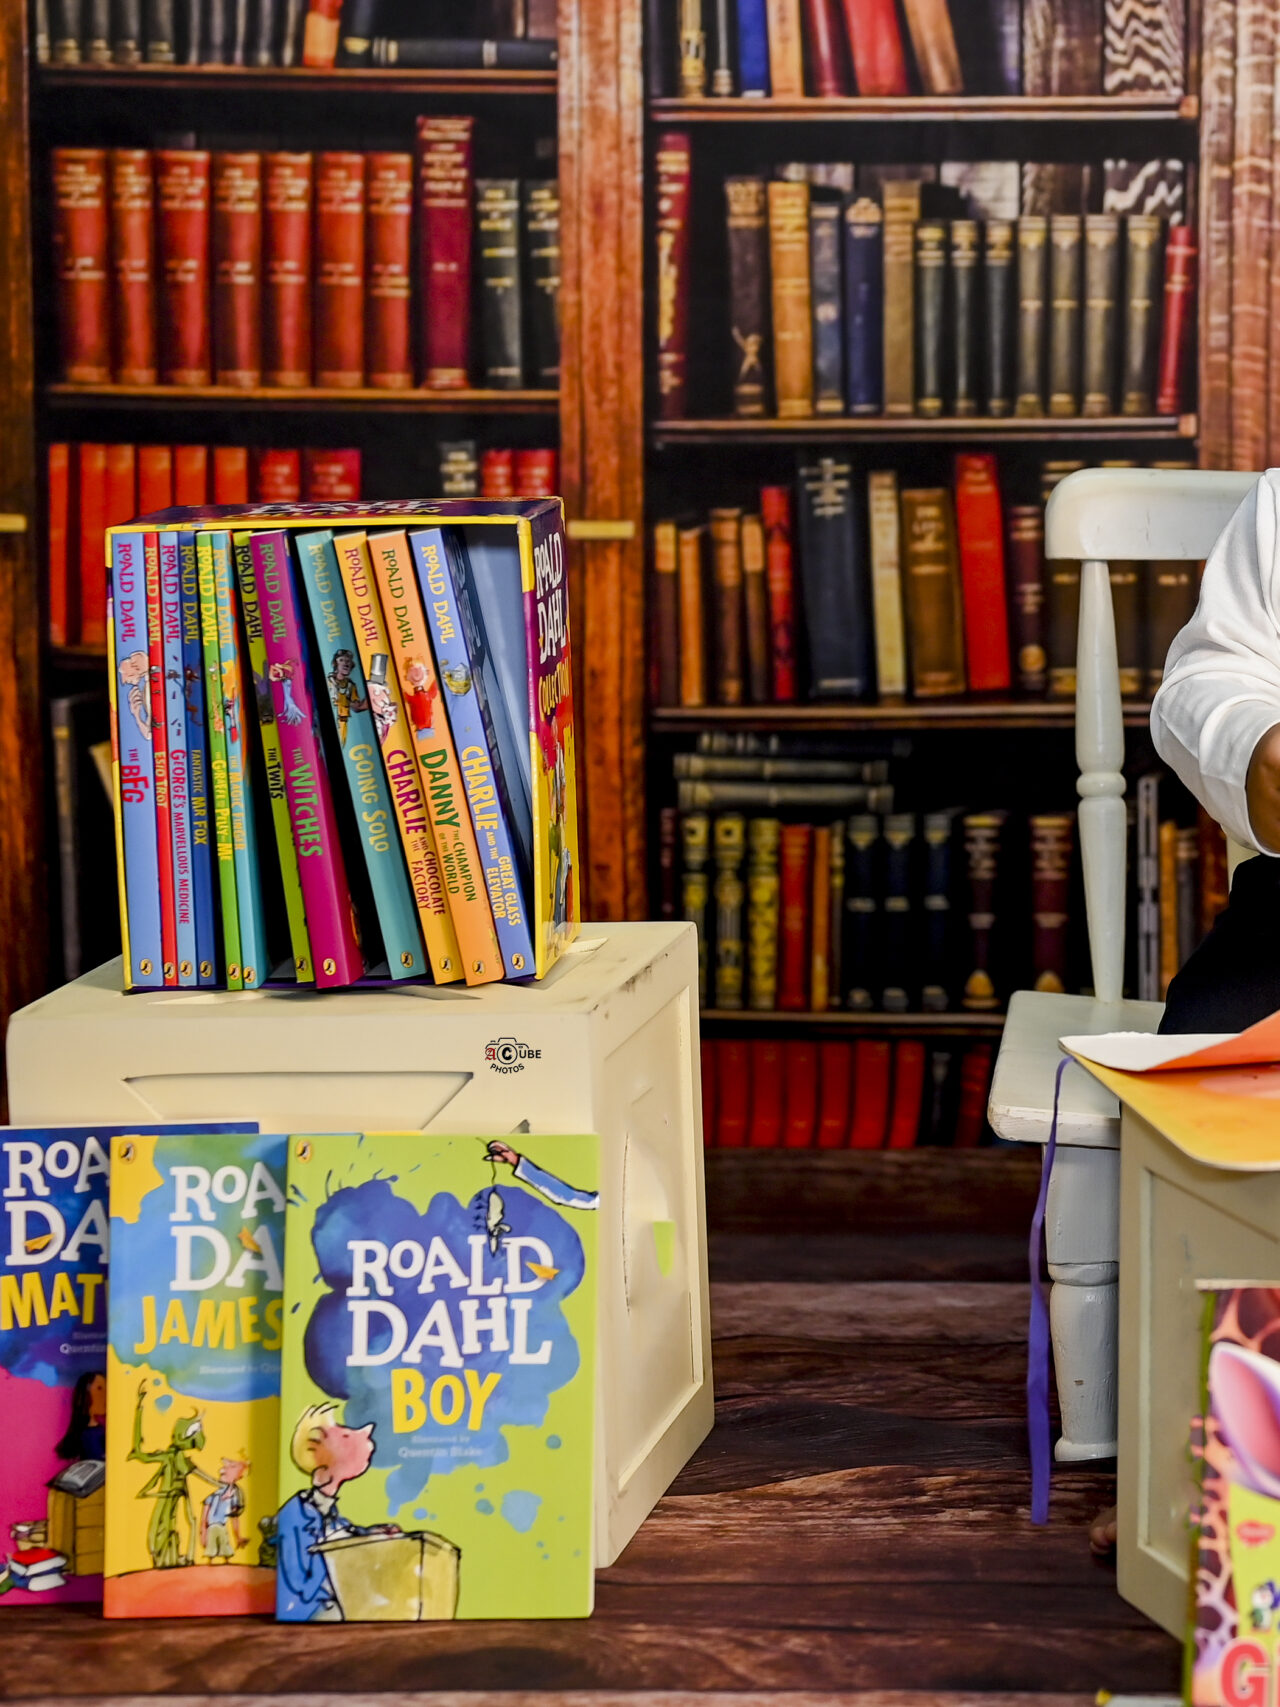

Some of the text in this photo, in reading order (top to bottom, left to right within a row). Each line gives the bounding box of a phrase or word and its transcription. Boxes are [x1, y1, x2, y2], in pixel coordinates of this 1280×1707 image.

[118, 543, 136, 642] ROALD DAHL
[162, 545, 181, 643] ROALD DAHL
[180, 545, 200, 644] ROALD DAHL
[197, 545, 218, 646] ROALD DAHL
[235, 545, 263, 643] ROALD DAHL
[259, 542, 287, 643] ROALD DAHL
[308, 543, 342, 642] ROALD DAHL
[344, 547, 379, 646] ROALD DAHL
[382, 549, 414, 648] ROALD DAHL
[421, 544, 456, 644] ROALD DAHL
[534, 532, 563, 600] ROALD
[537, 589, 567, 664] DAHL
[121, 765, 149, 803] BFG
[267, 748, 277, 762] THE
[268, 762, 284, 800] TWITS
[419, 749, 460, 828] DANNY
[461, 745, 499, 831] CHARLIE
[191, 749, 208, 845] FANTASTIC MR FOX
[289, 763, 323, 857] WITCHES
[349, 744, 389, 852] GOING SOLO
[386, 750, 427, 835] CHARLIE
[173, 812, 189, 875] MARVELLOUS
[442, 853, 460, 894] WORLD
[453, 842, 477, 902] CHAMPION
[178, 879, 190, 924] MEDICINE
[410, 861, 431, 909] FACTORY
[423, 850, 446, 916] CHOCOLATE
[486, 867, 506, 919] ELEVATOR
[498, 855, 521, 926] GREAT GLASS
[3, 1136, 109, 1197] ROA
[346, 1234, 554, 1297] ROALD
[0, 1272, 109, 1331] MAT
[134, 1296, 284, 1354] JAMES
[346, 1297, 553, 1368] DAHL
[391, 1368, 502, 1434] BOY
